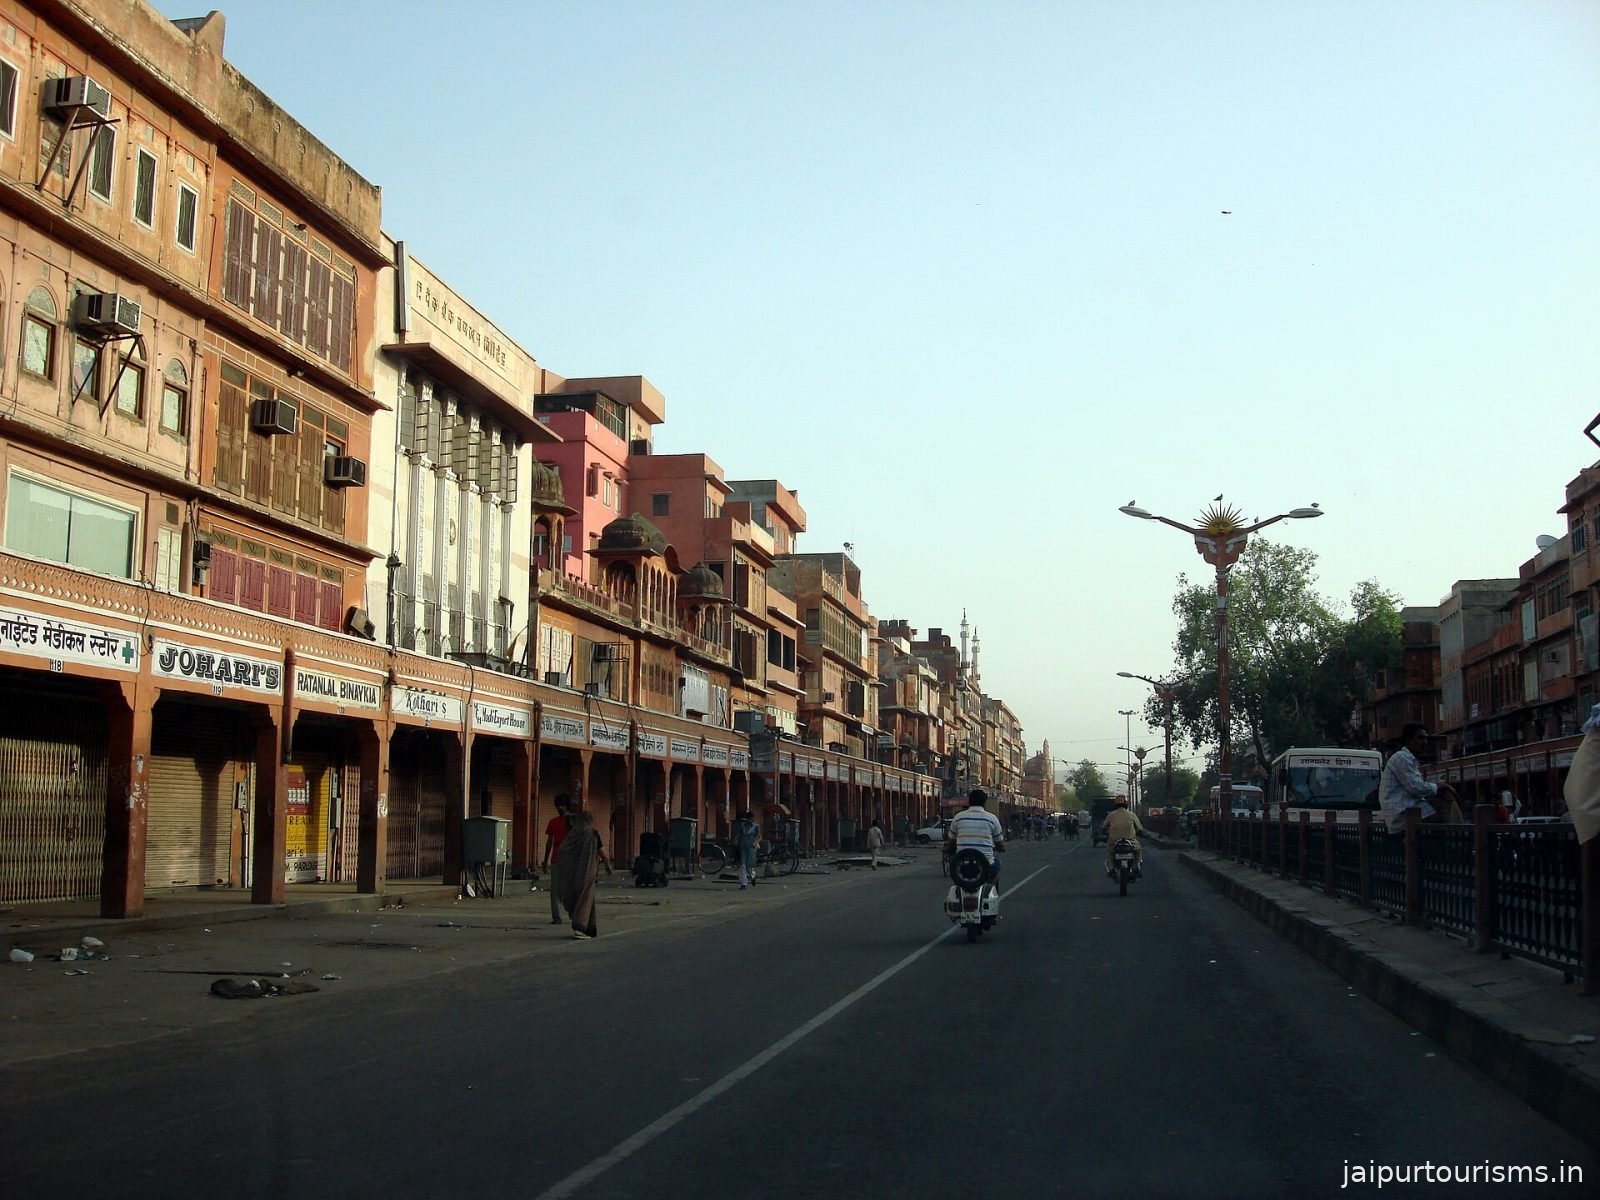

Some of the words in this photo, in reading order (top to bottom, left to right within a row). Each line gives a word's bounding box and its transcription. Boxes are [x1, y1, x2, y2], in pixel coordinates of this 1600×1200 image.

[0, 614, 38, 648] नाईटेड
[42, 620, 85, 654] मेडीकल
[89, 631, 120, 661] स्टोर
[51, 659, 62, 672] 118
[159, 647, 280, 690] JOHARI'S
[213, 684, 222, 695] 119
[297, 671, 338, 698] RATANLAL
[340, 681, 377, 705] BINAYKIA
